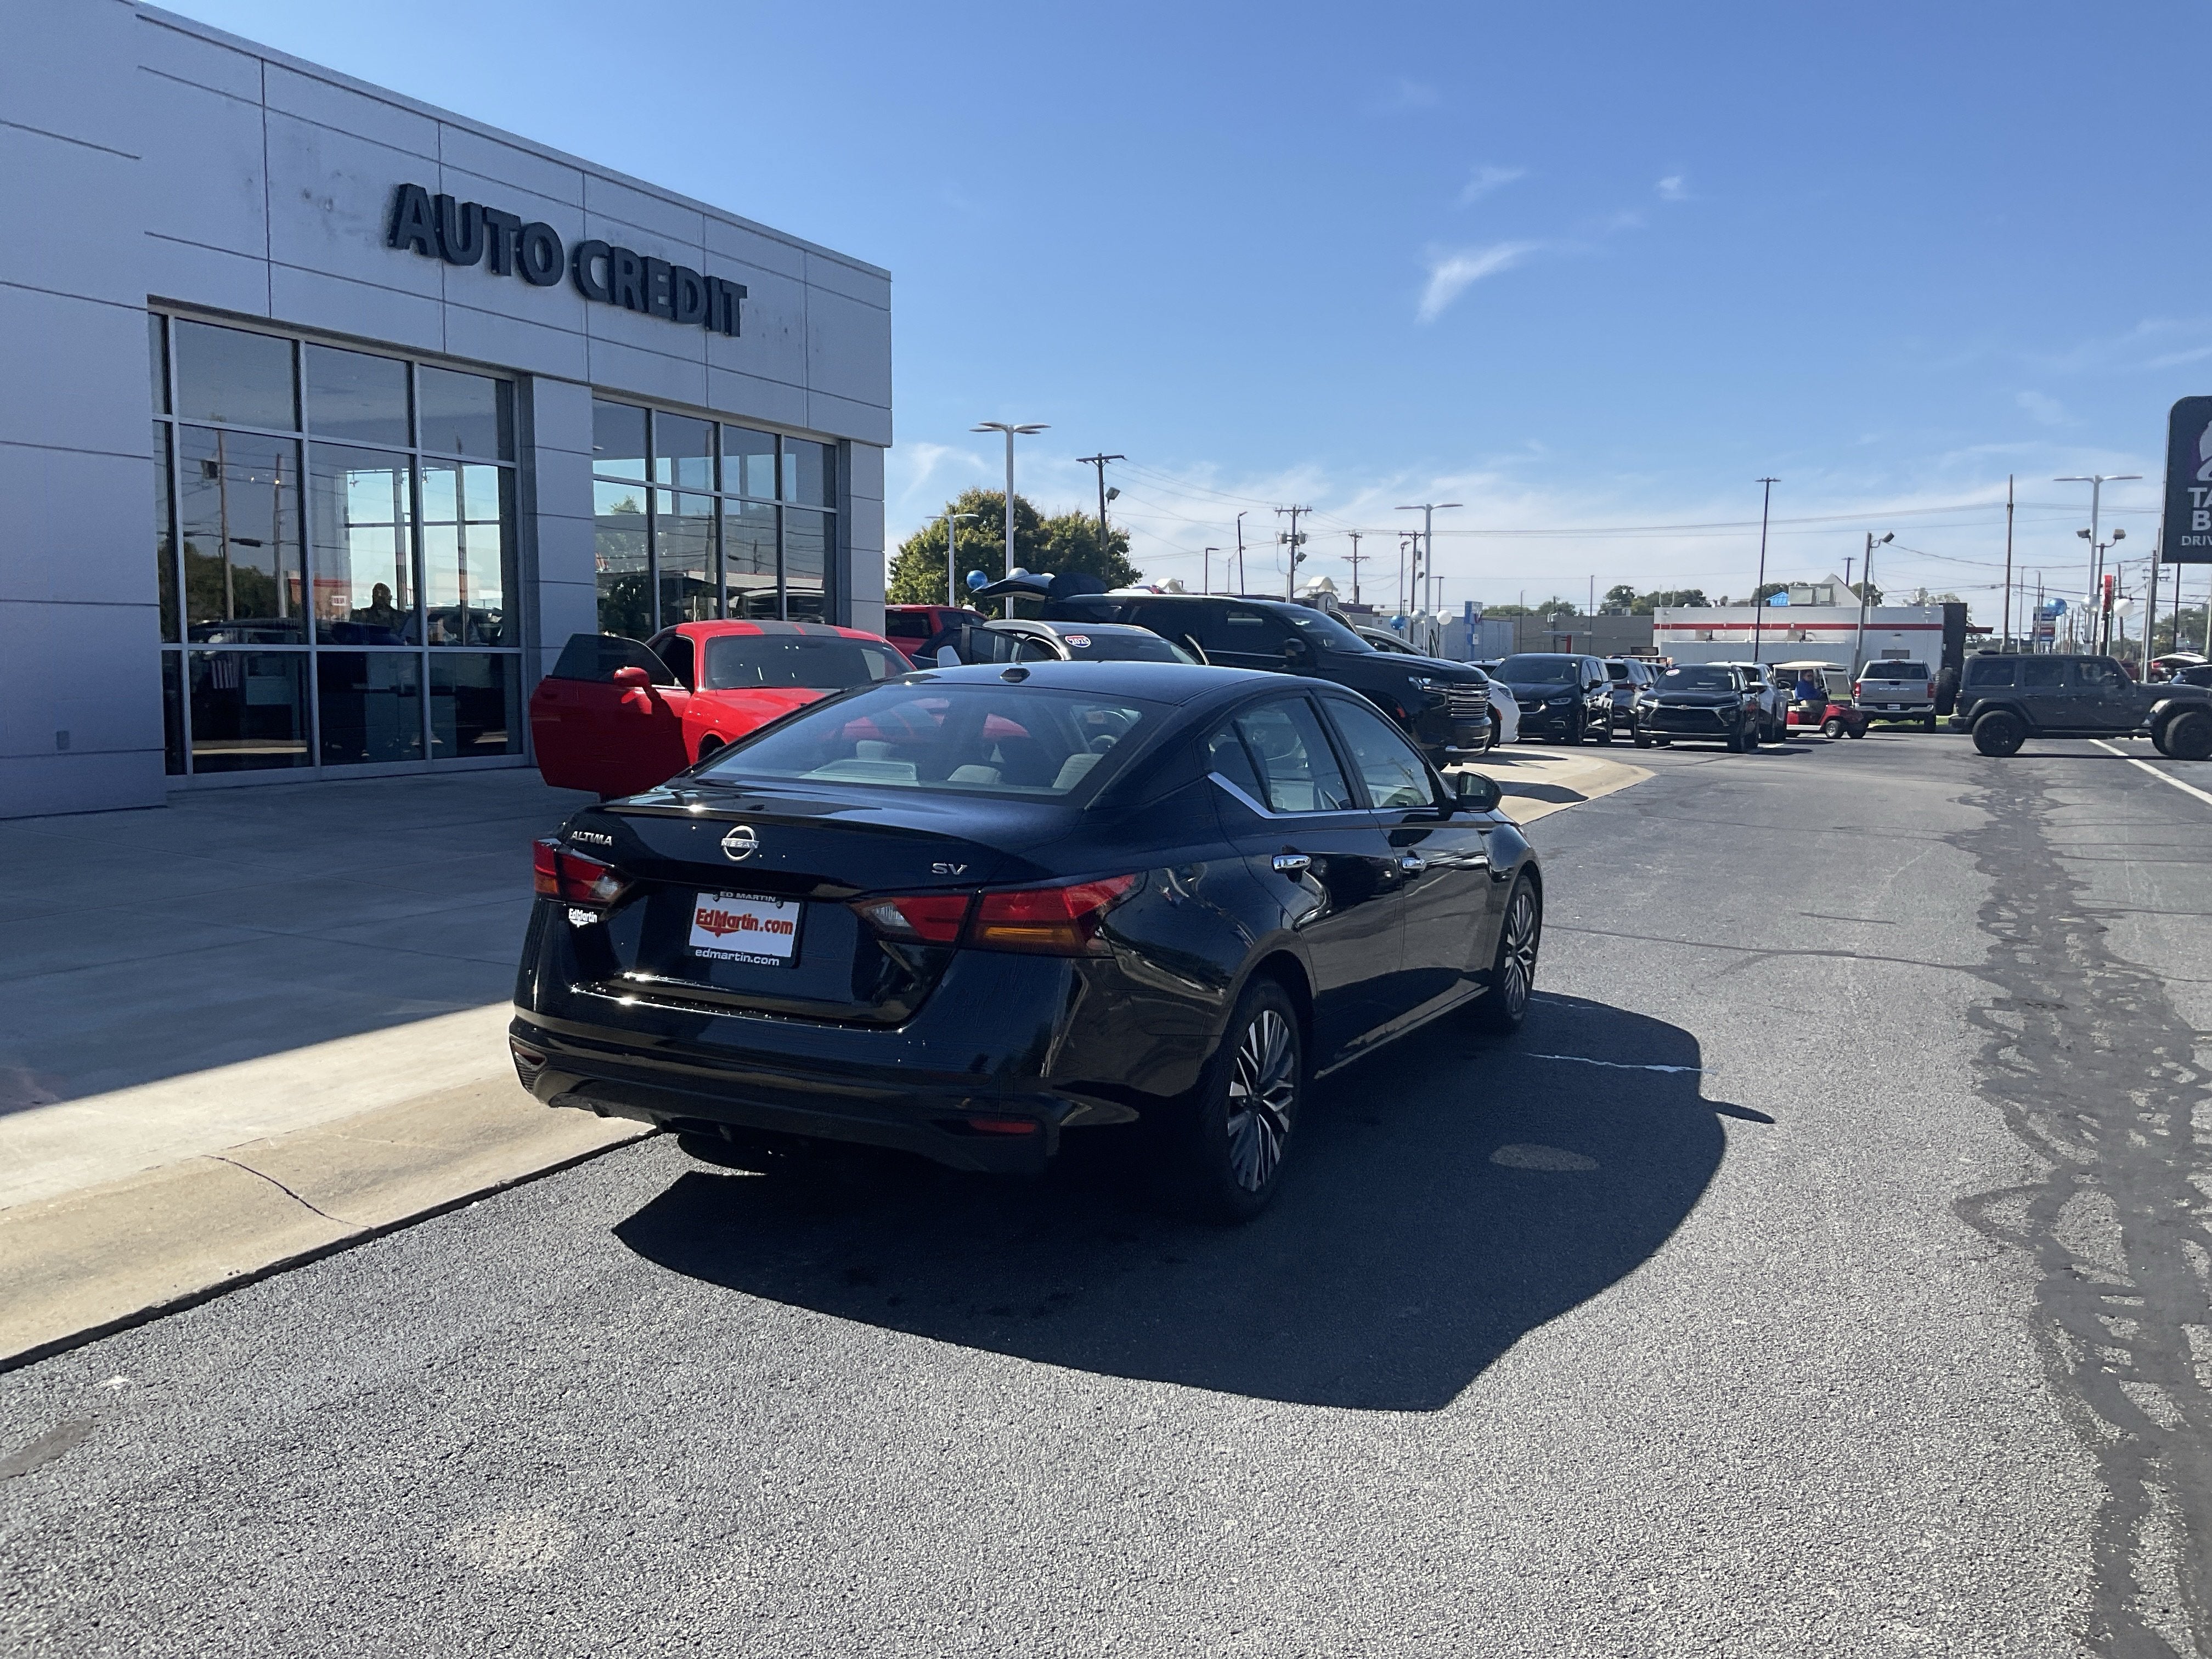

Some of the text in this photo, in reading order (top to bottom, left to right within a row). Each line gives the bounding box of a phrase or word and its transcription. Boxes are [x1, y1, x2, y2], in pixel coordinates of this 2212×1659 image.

[388, 183, 747, 337] AUTO CREDIT
[570, 831, 613, 846] ALTIMA
[721, 839, 758, 849] NISSAN
[932, 862, 967, 875] SV
[736, 893, 776, 902] MARTIN
[568, 908, 597, 923] EdMartin
[695, 949, 780, 966] edmartin.com
